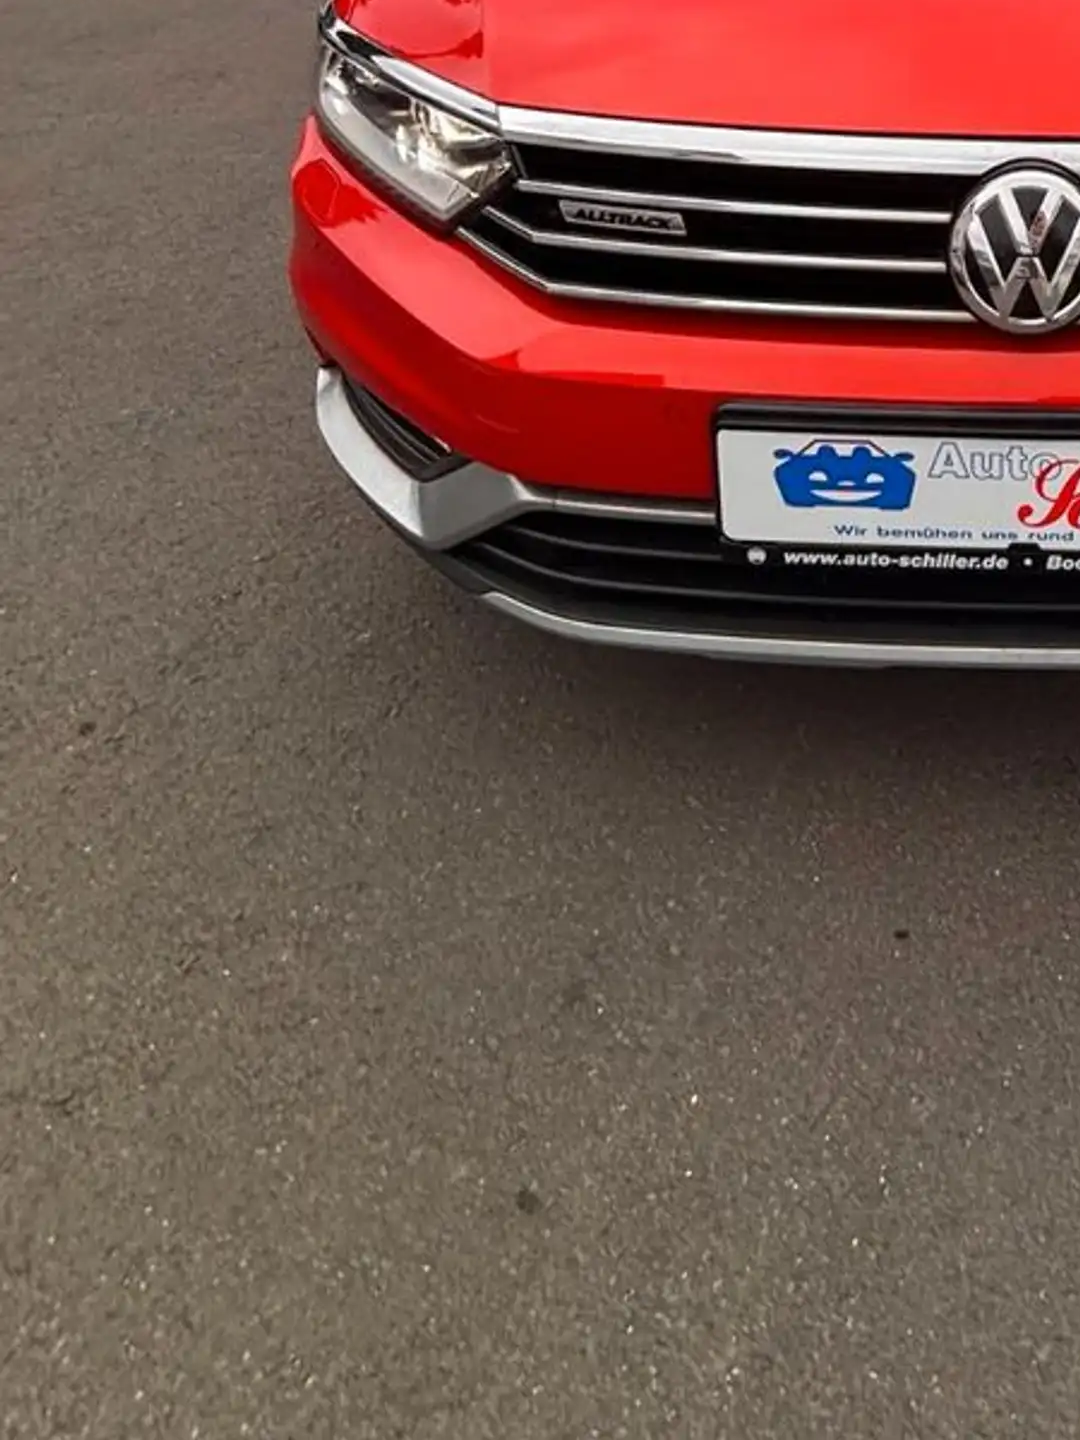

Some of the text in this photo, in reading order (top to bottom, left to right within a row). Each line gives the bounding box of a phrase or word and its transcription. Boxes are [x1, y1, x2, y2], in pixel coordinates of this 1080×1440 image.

[574, 207, 670, 231] ALLTRACK
[927, 440, 1062, 481] Auto
[834, 524, 867, 537] Wir
[876, 525, 972, 540] bemühen
[981, 531, 1018, 541] uns
[1028, 530, 1074, 542] rund
[784, 551, 1009, 570] www.auto-schiller.de
